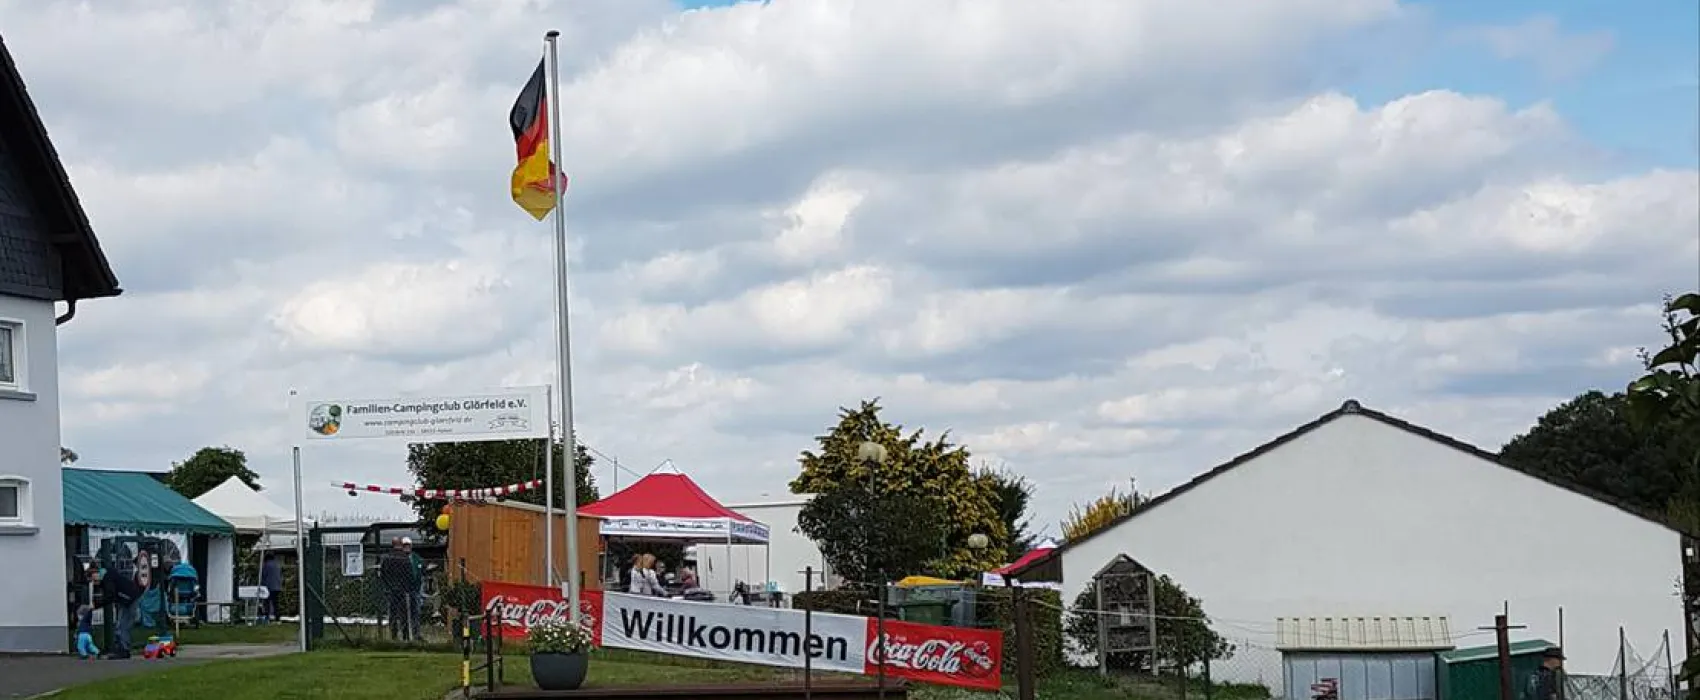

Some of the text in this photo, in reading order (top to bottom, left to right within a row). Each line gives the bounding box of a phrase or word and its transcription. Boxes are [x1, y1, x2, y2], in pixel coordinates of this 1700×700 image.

[347, 399, 527, 414] Familien-Campingclub Glörfeld e.V.
[620, 607, 848, 661] Willkommen
[868, 633, 966, 673] Coca-Cola
